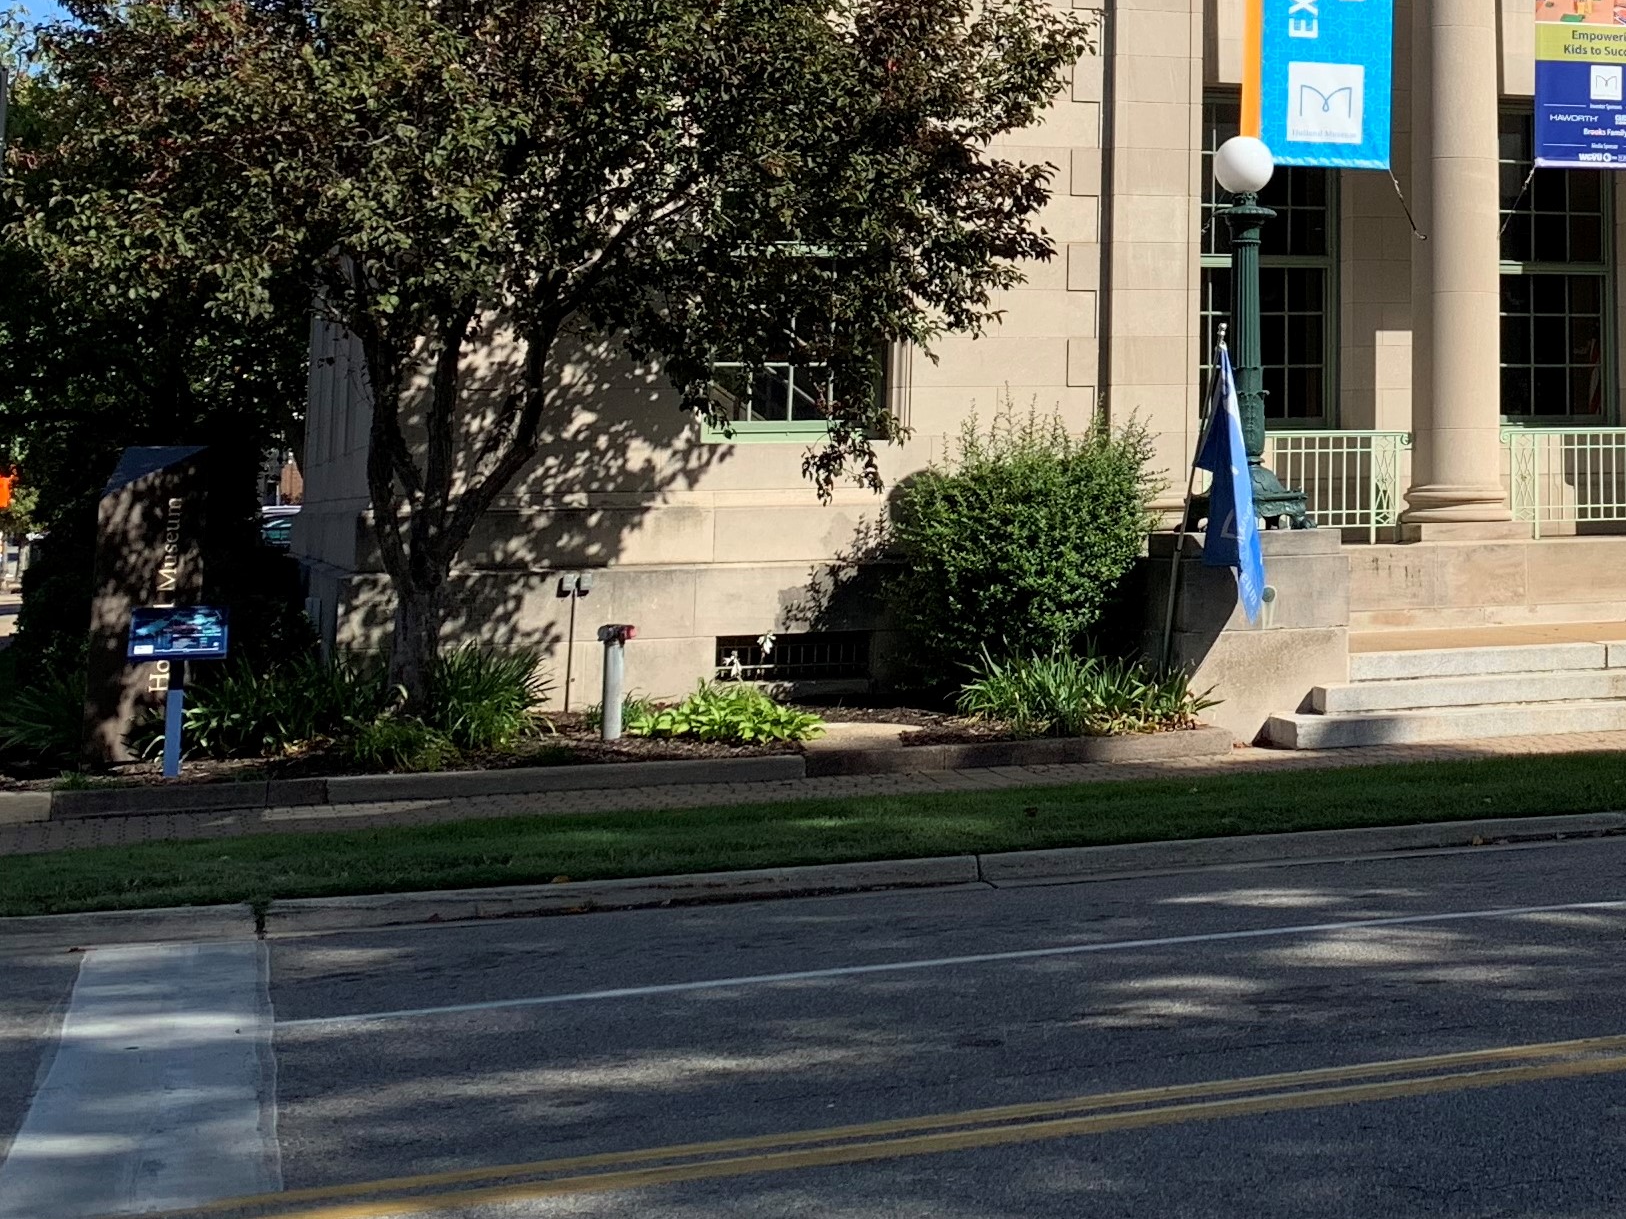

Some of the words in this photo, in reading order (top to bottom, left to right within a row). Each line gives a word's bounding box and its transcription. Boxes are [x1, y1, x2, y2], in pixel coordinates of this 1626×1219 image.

[1563, 44, 1588, 55] Kids
[1590, 45, 1602, 56] to
[1549, 114, 1599, 122] HAWORTH
[1583, 128, 1607, 136] Brooks
[157, 497, 184, 592] Museum
